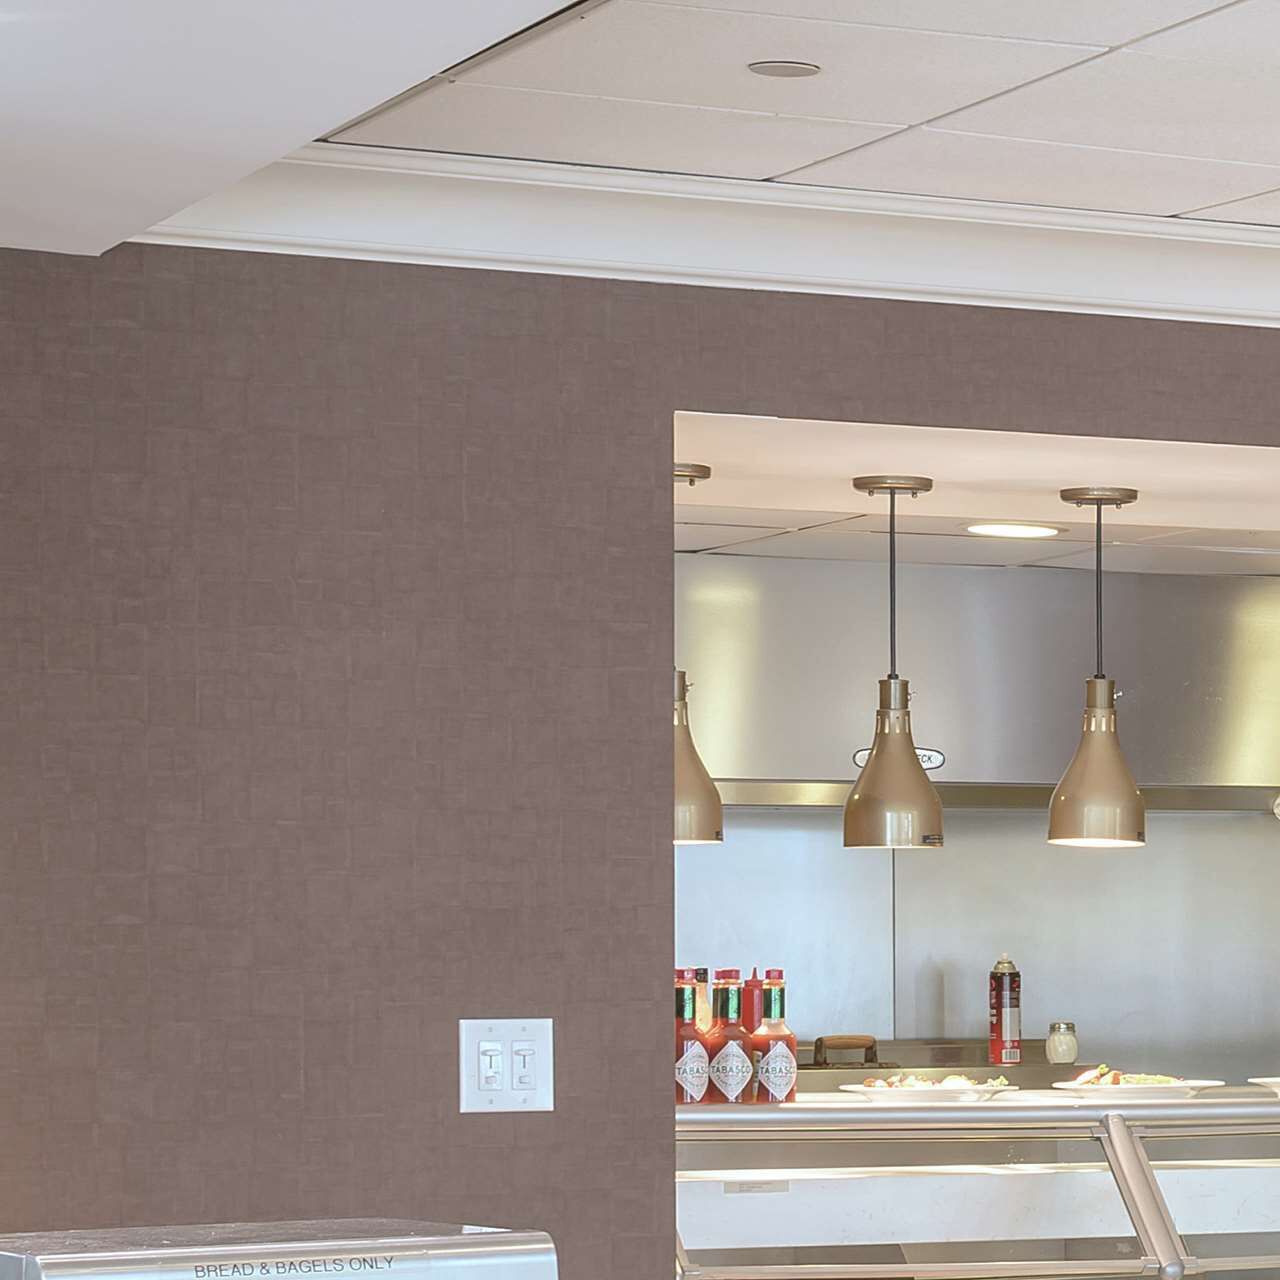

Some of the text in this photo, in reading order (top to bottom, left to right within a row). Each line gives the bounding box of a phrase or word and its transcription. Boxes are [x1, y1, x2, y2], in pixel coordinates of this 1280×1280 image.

[711, 1065, 751, 1074] TABASCO
[194, 1256, 394, 1279] BREAD & BAGELS ONLY
